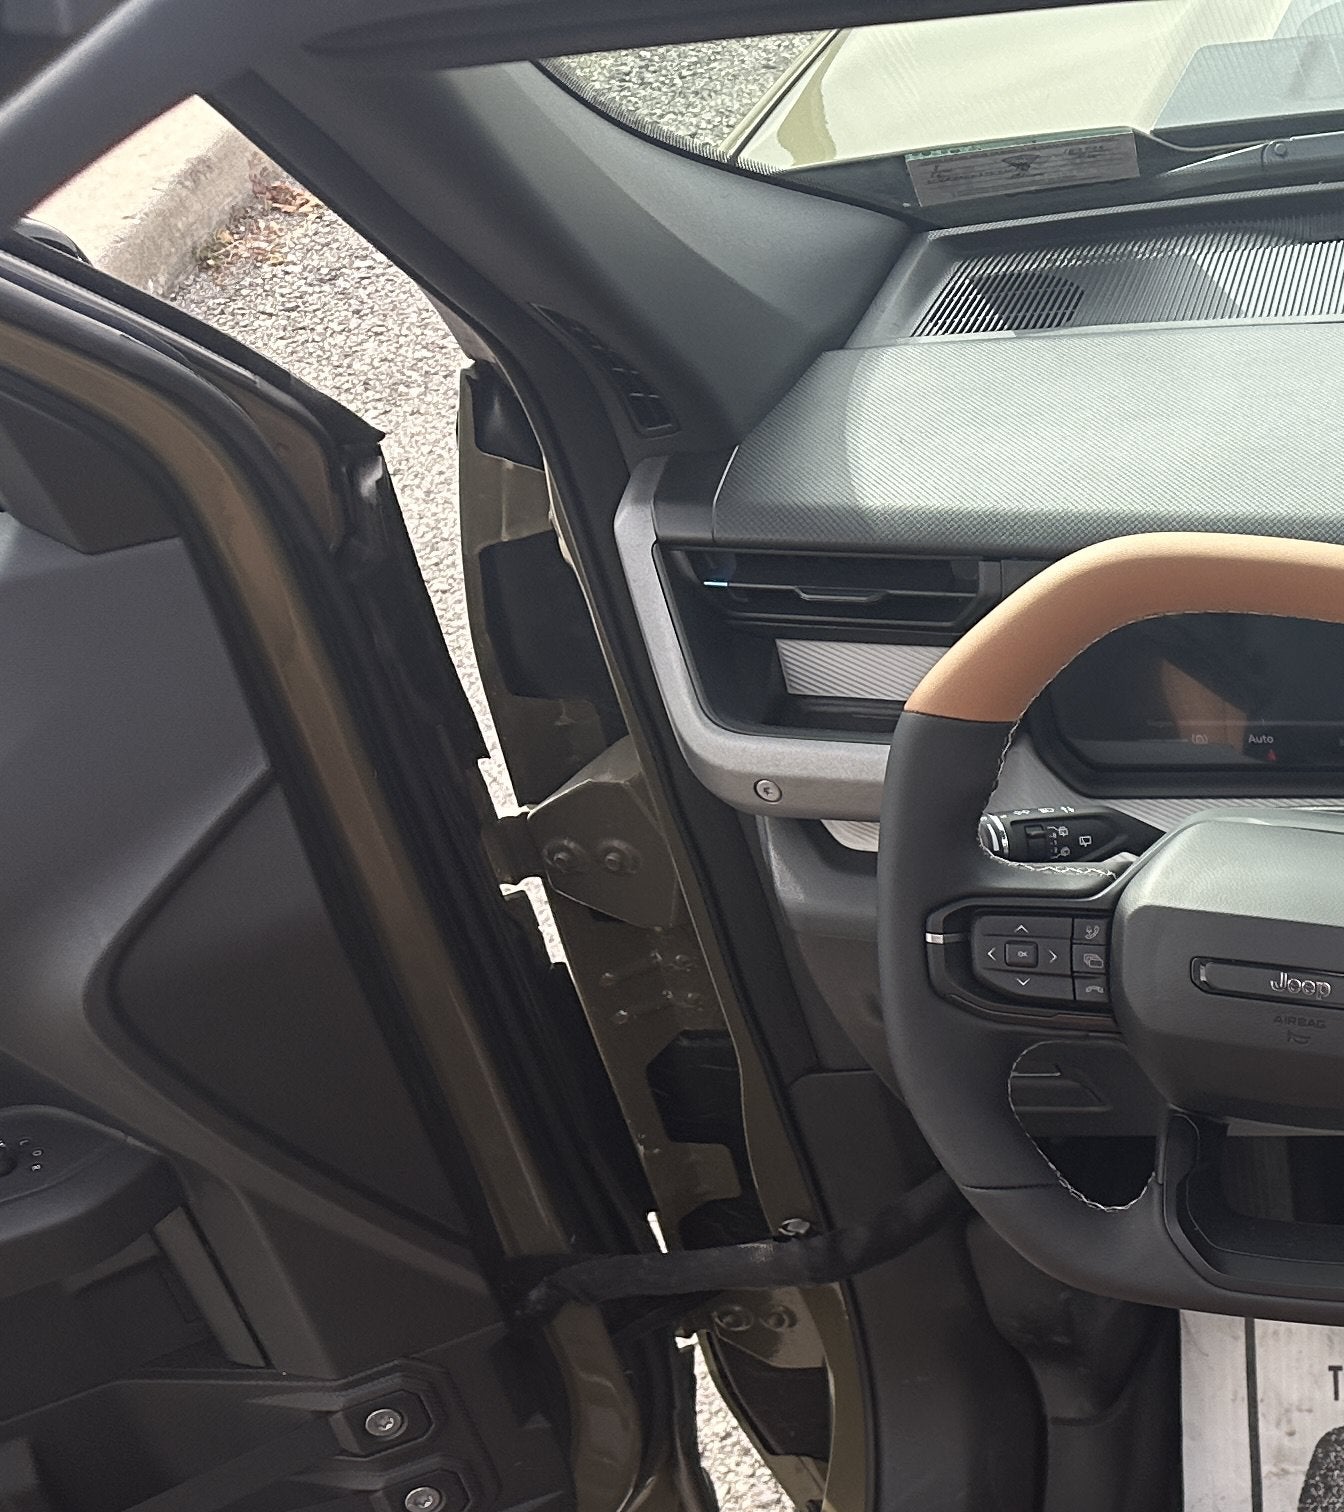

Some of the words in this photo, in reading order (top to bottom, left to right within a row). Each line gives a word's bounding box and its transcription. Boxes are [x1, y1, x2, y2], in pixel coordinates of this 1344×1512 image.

[1248, 733, 1274, 745] Auto
[1269, 971, 1332, 1001] Jeep
[1272, 1014, 1327, 1029] AIRBAG
